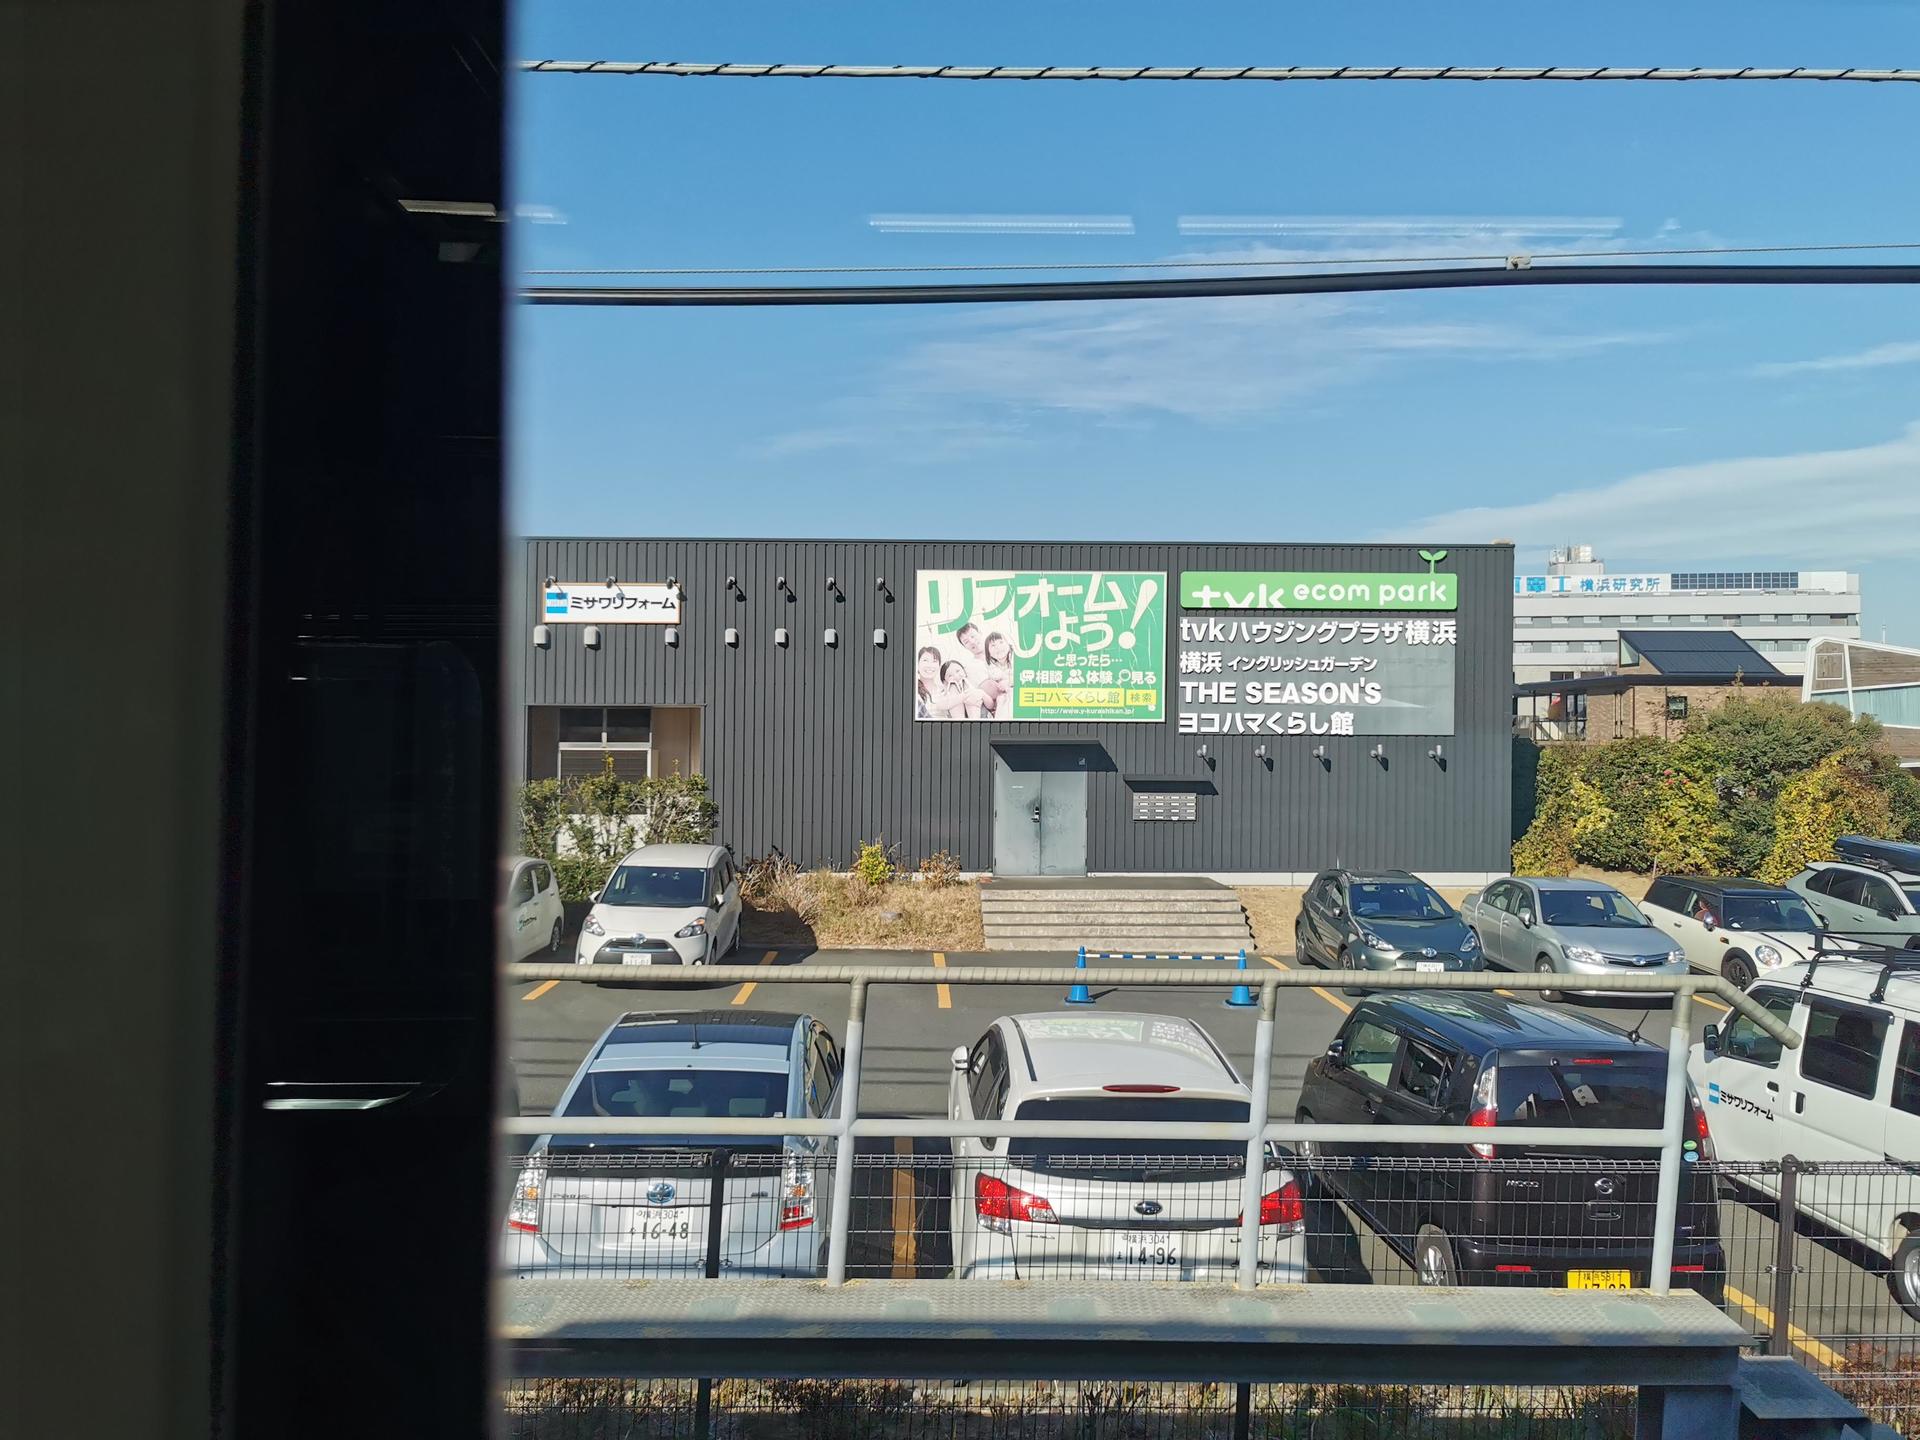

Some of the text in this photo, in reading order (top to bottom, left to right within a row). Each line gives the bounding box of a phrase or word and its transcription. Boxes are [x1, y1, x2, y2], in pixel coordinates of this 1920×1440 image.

[1293, 584, 1370, 602] ecom
[1379, 580, 1447, 606] park
[1579, 577, 1661, 593] 横浜研究所
[570, 596, 676, 611] ミサワリフォーム
[927, 574, 1128, 635] リフォーム
[1179, 651, 1378, 674] 横浜 イングリッシュガーデン
[1036, 670, 1156, 685] 相談 体験 見る
[1024, 690, 1152, 704] ヨコハマくらし館 検索
[1180, 677, 1382, 706] THE SEASON'S
[1178, 711, 1354, 736] ヨコハマくらし館
[1720, 1090, 1774, 1121] ミサワリフォーム
[642, 1222, 688, 1240] 16-48
[1148, 1234, 1165, 1244] 304
[1130, 1247, 1176, 1265] 14-96
